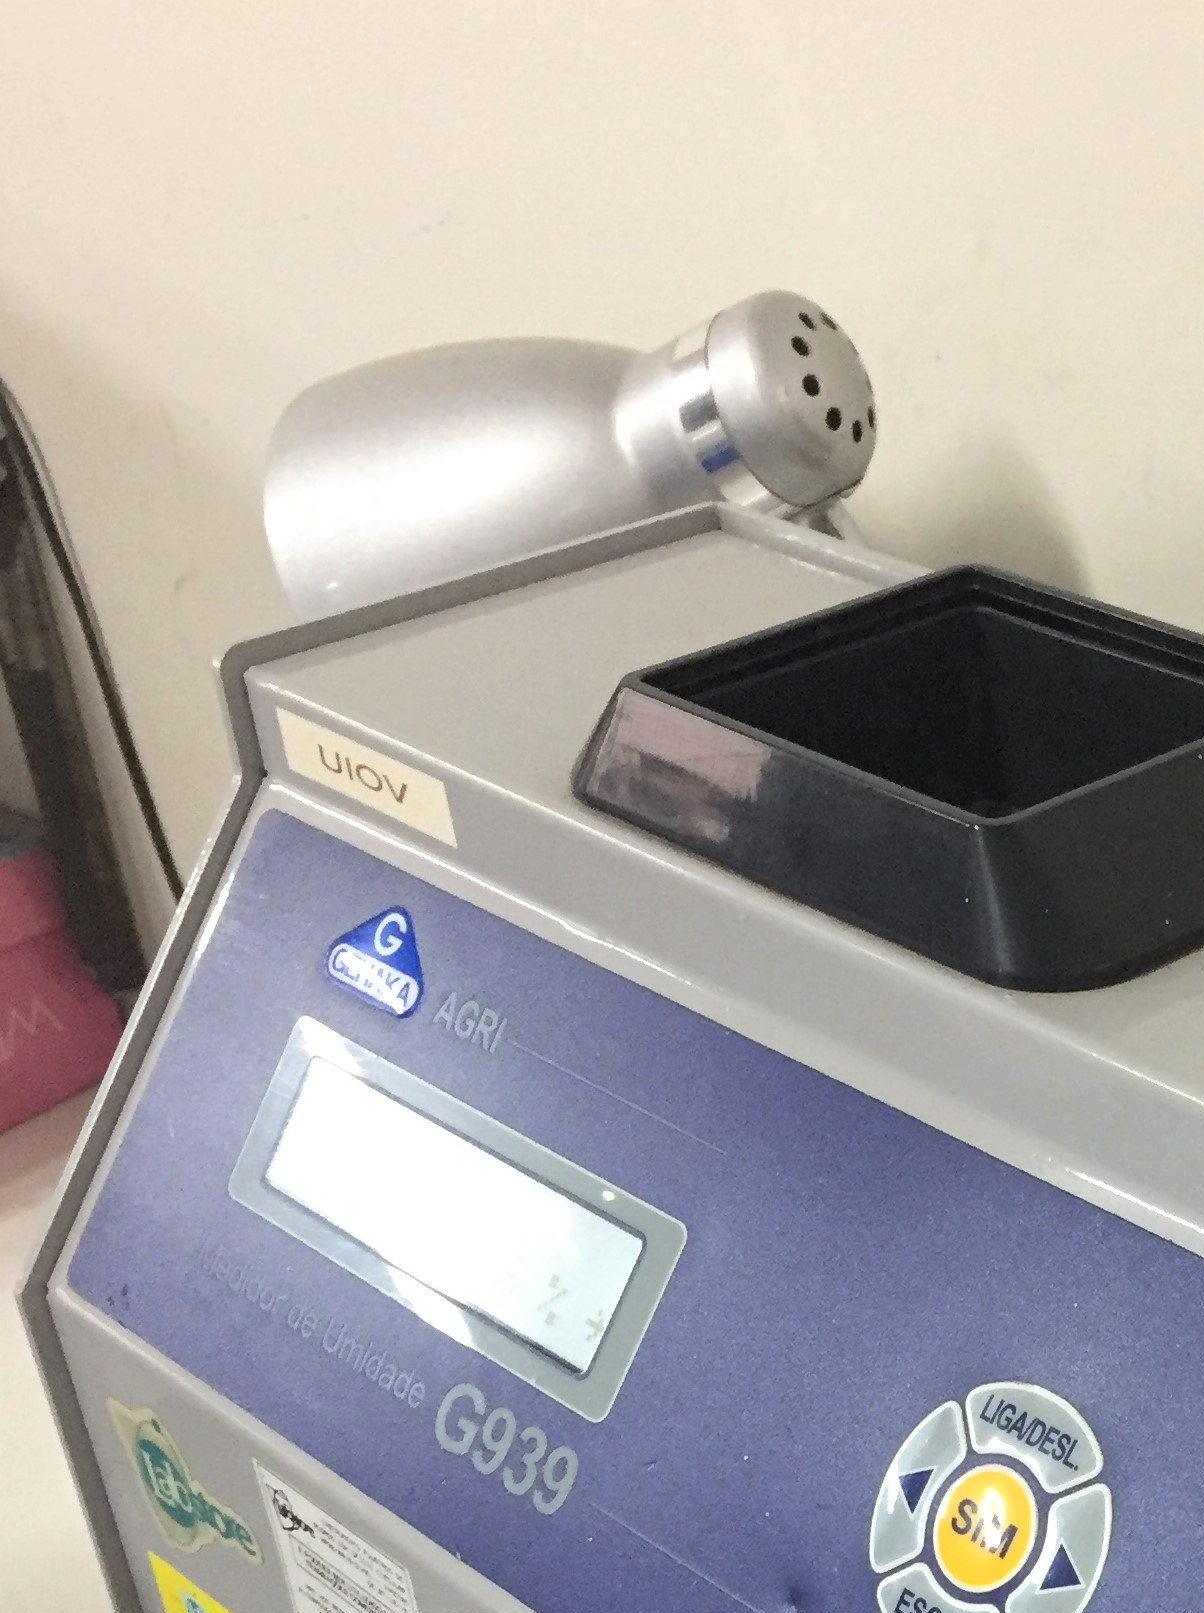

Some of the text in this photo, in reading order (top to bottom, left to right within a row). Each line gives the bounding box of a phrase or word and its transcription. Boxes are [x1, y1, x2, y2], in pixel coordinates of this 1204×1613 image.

[373, 912, 408, 956] G
[432, 991, 507, 1055] AGRI
[199, 1245, 579, 1515] Medidor de Umidade G939
[979, 1394, 1079, 1471] LIGA/DESL.
